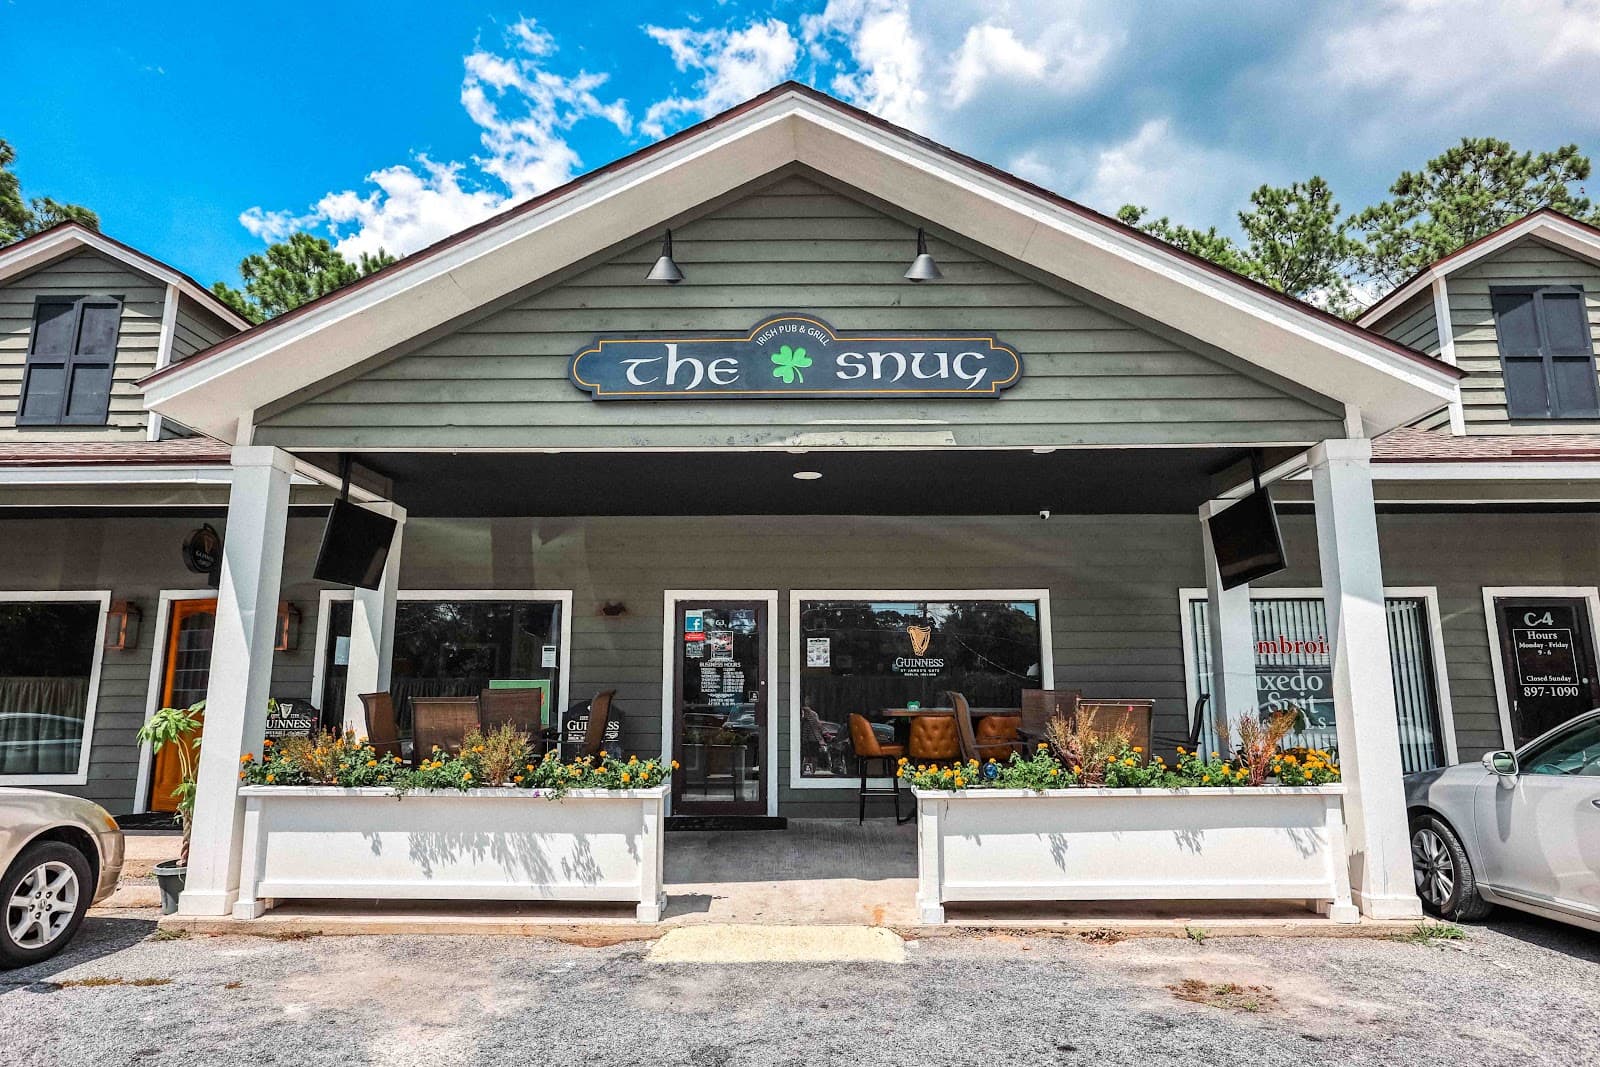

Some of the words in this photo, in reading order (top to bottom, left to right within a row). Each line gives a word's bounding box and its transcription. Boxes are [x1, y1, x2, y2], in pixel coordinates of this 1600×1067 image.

[756, 328, 778, 346] IRISH
[779, 324, 798, 334] PUB
[799, 325, 806, 334] &
[807, 327, 831, 346] GRILL
[1527, 630, 1558, 640] Hours
[1254, 635, 1330, 654] mbroi
[1549, 675, 1572, 683] Sunday
[1523, 686, 1579, 697] 897-1090
[266, 719, 311, 729] UINNESS
[566, 720, 620, 731] GUISS
